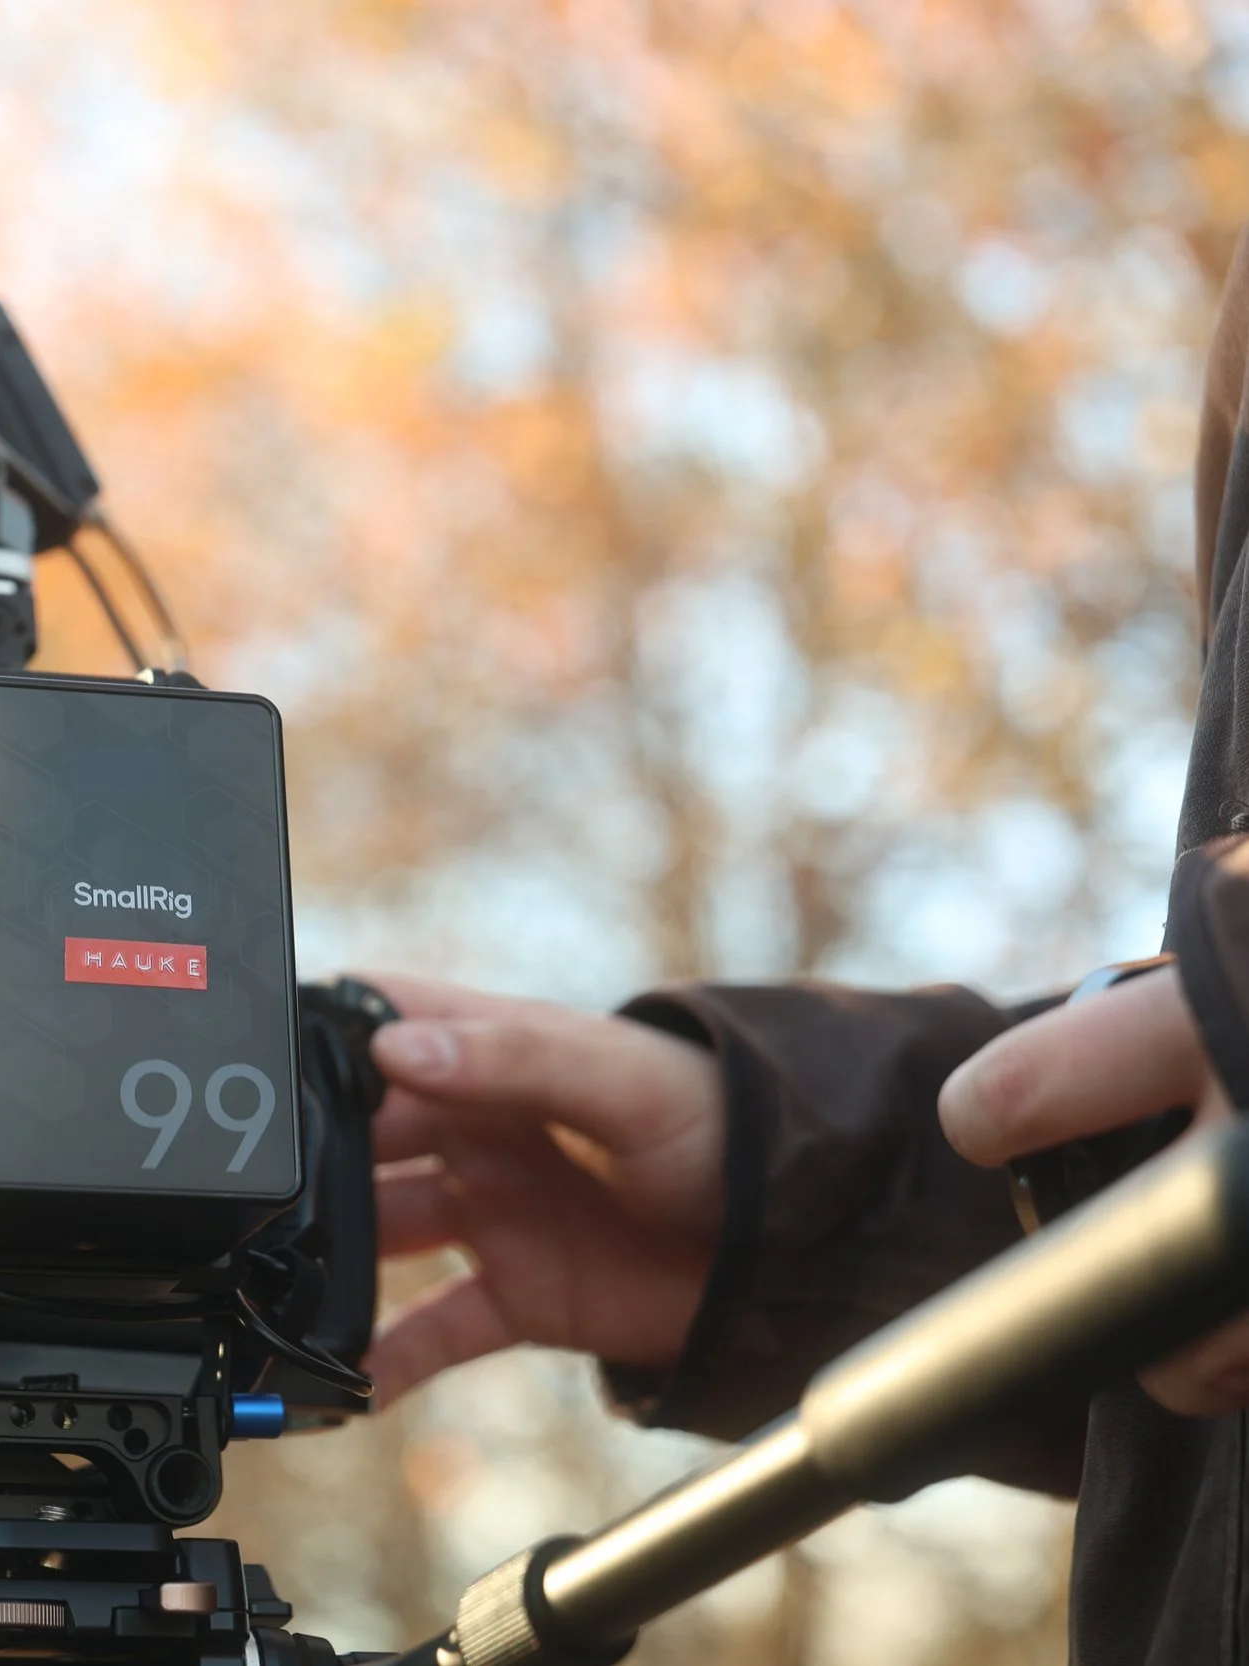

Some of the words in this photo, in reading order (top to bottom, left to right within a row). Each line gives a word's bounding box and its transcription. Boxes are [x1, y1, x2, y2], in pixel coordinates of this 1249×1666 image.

[73, 882, 192, 918] SmallRig
[85, 951, 201, 977] HAUKE
[120, 1060, 276, 1172] 99
